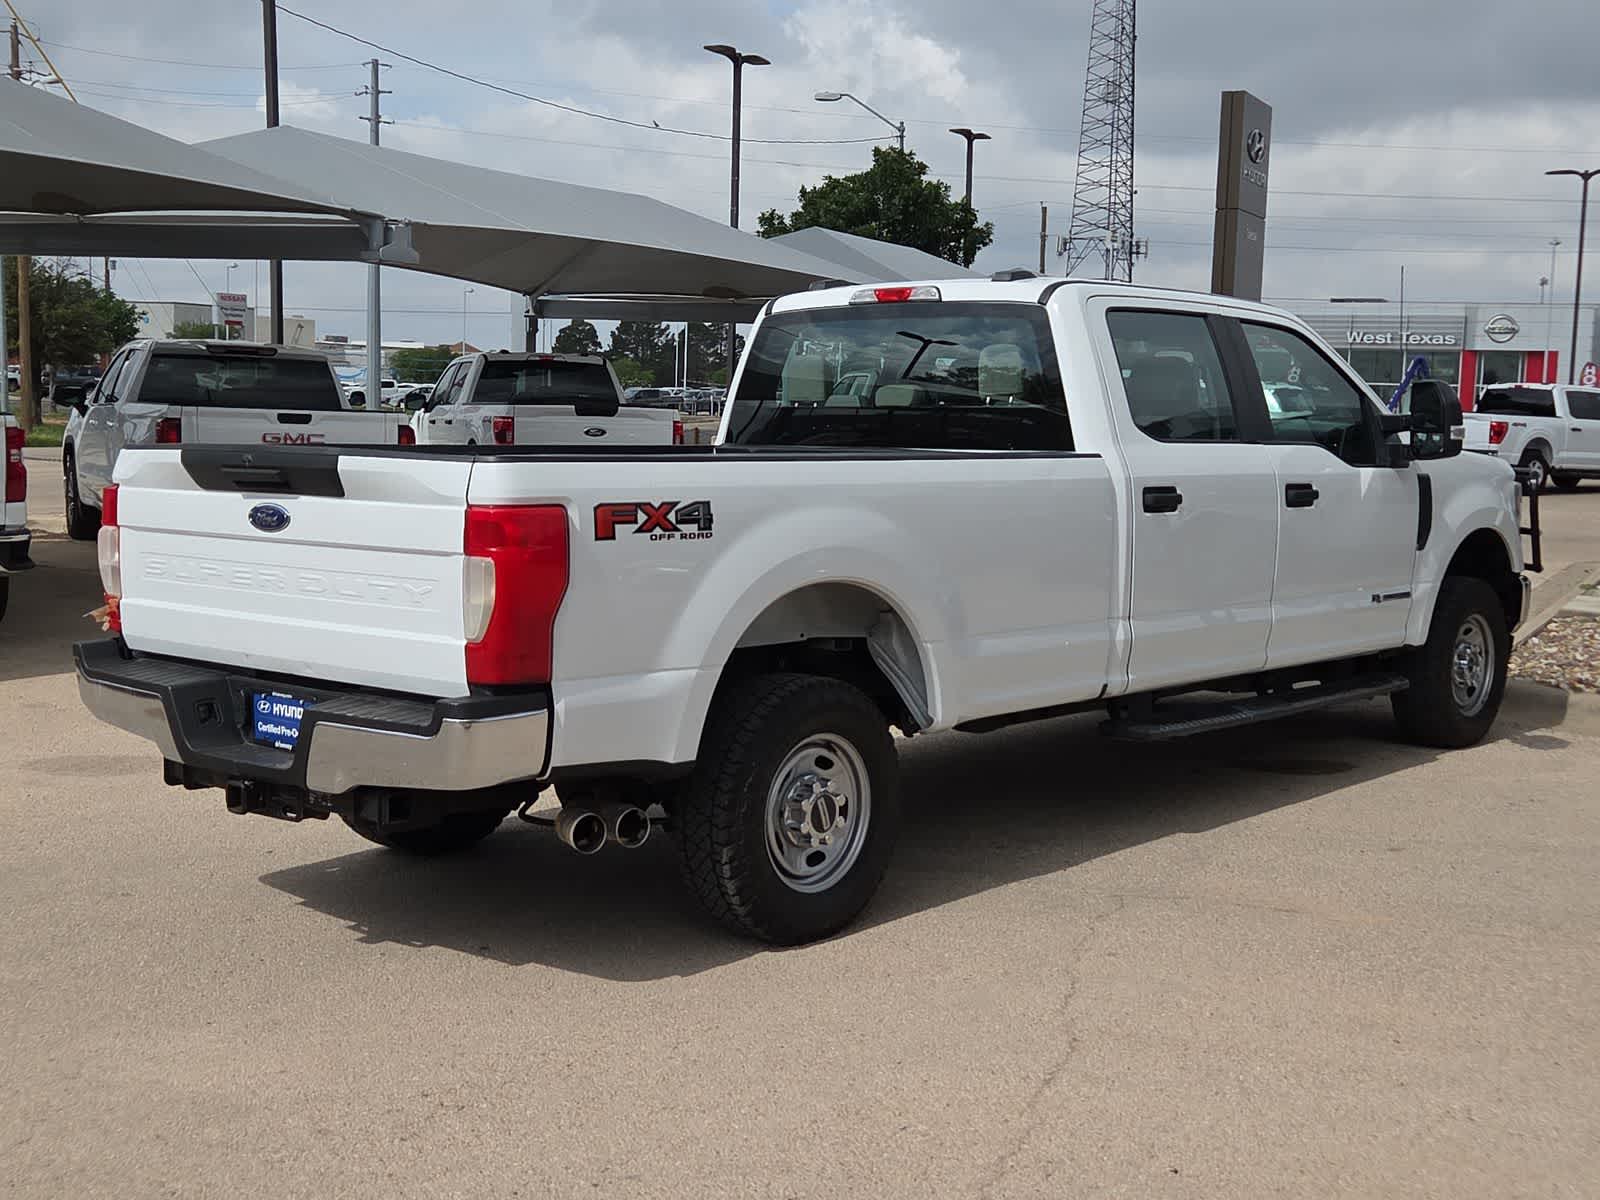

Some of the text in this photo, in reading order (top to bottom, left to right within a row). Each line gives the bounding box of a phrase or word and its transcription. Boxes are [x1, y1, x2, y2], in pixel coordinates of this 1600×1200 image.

[1346, 331, 1457, 345] West Texas
[261, 433, 326, 446] GMC
[593, 500, 714, 541] FX4
[649, 531, 713, 541] OFF ROAD
[143, 556, 434, 609] SUPER DUTY
[272, 702, 304, 720] HYUND
[281, 725, 299, 738] Pre-O
